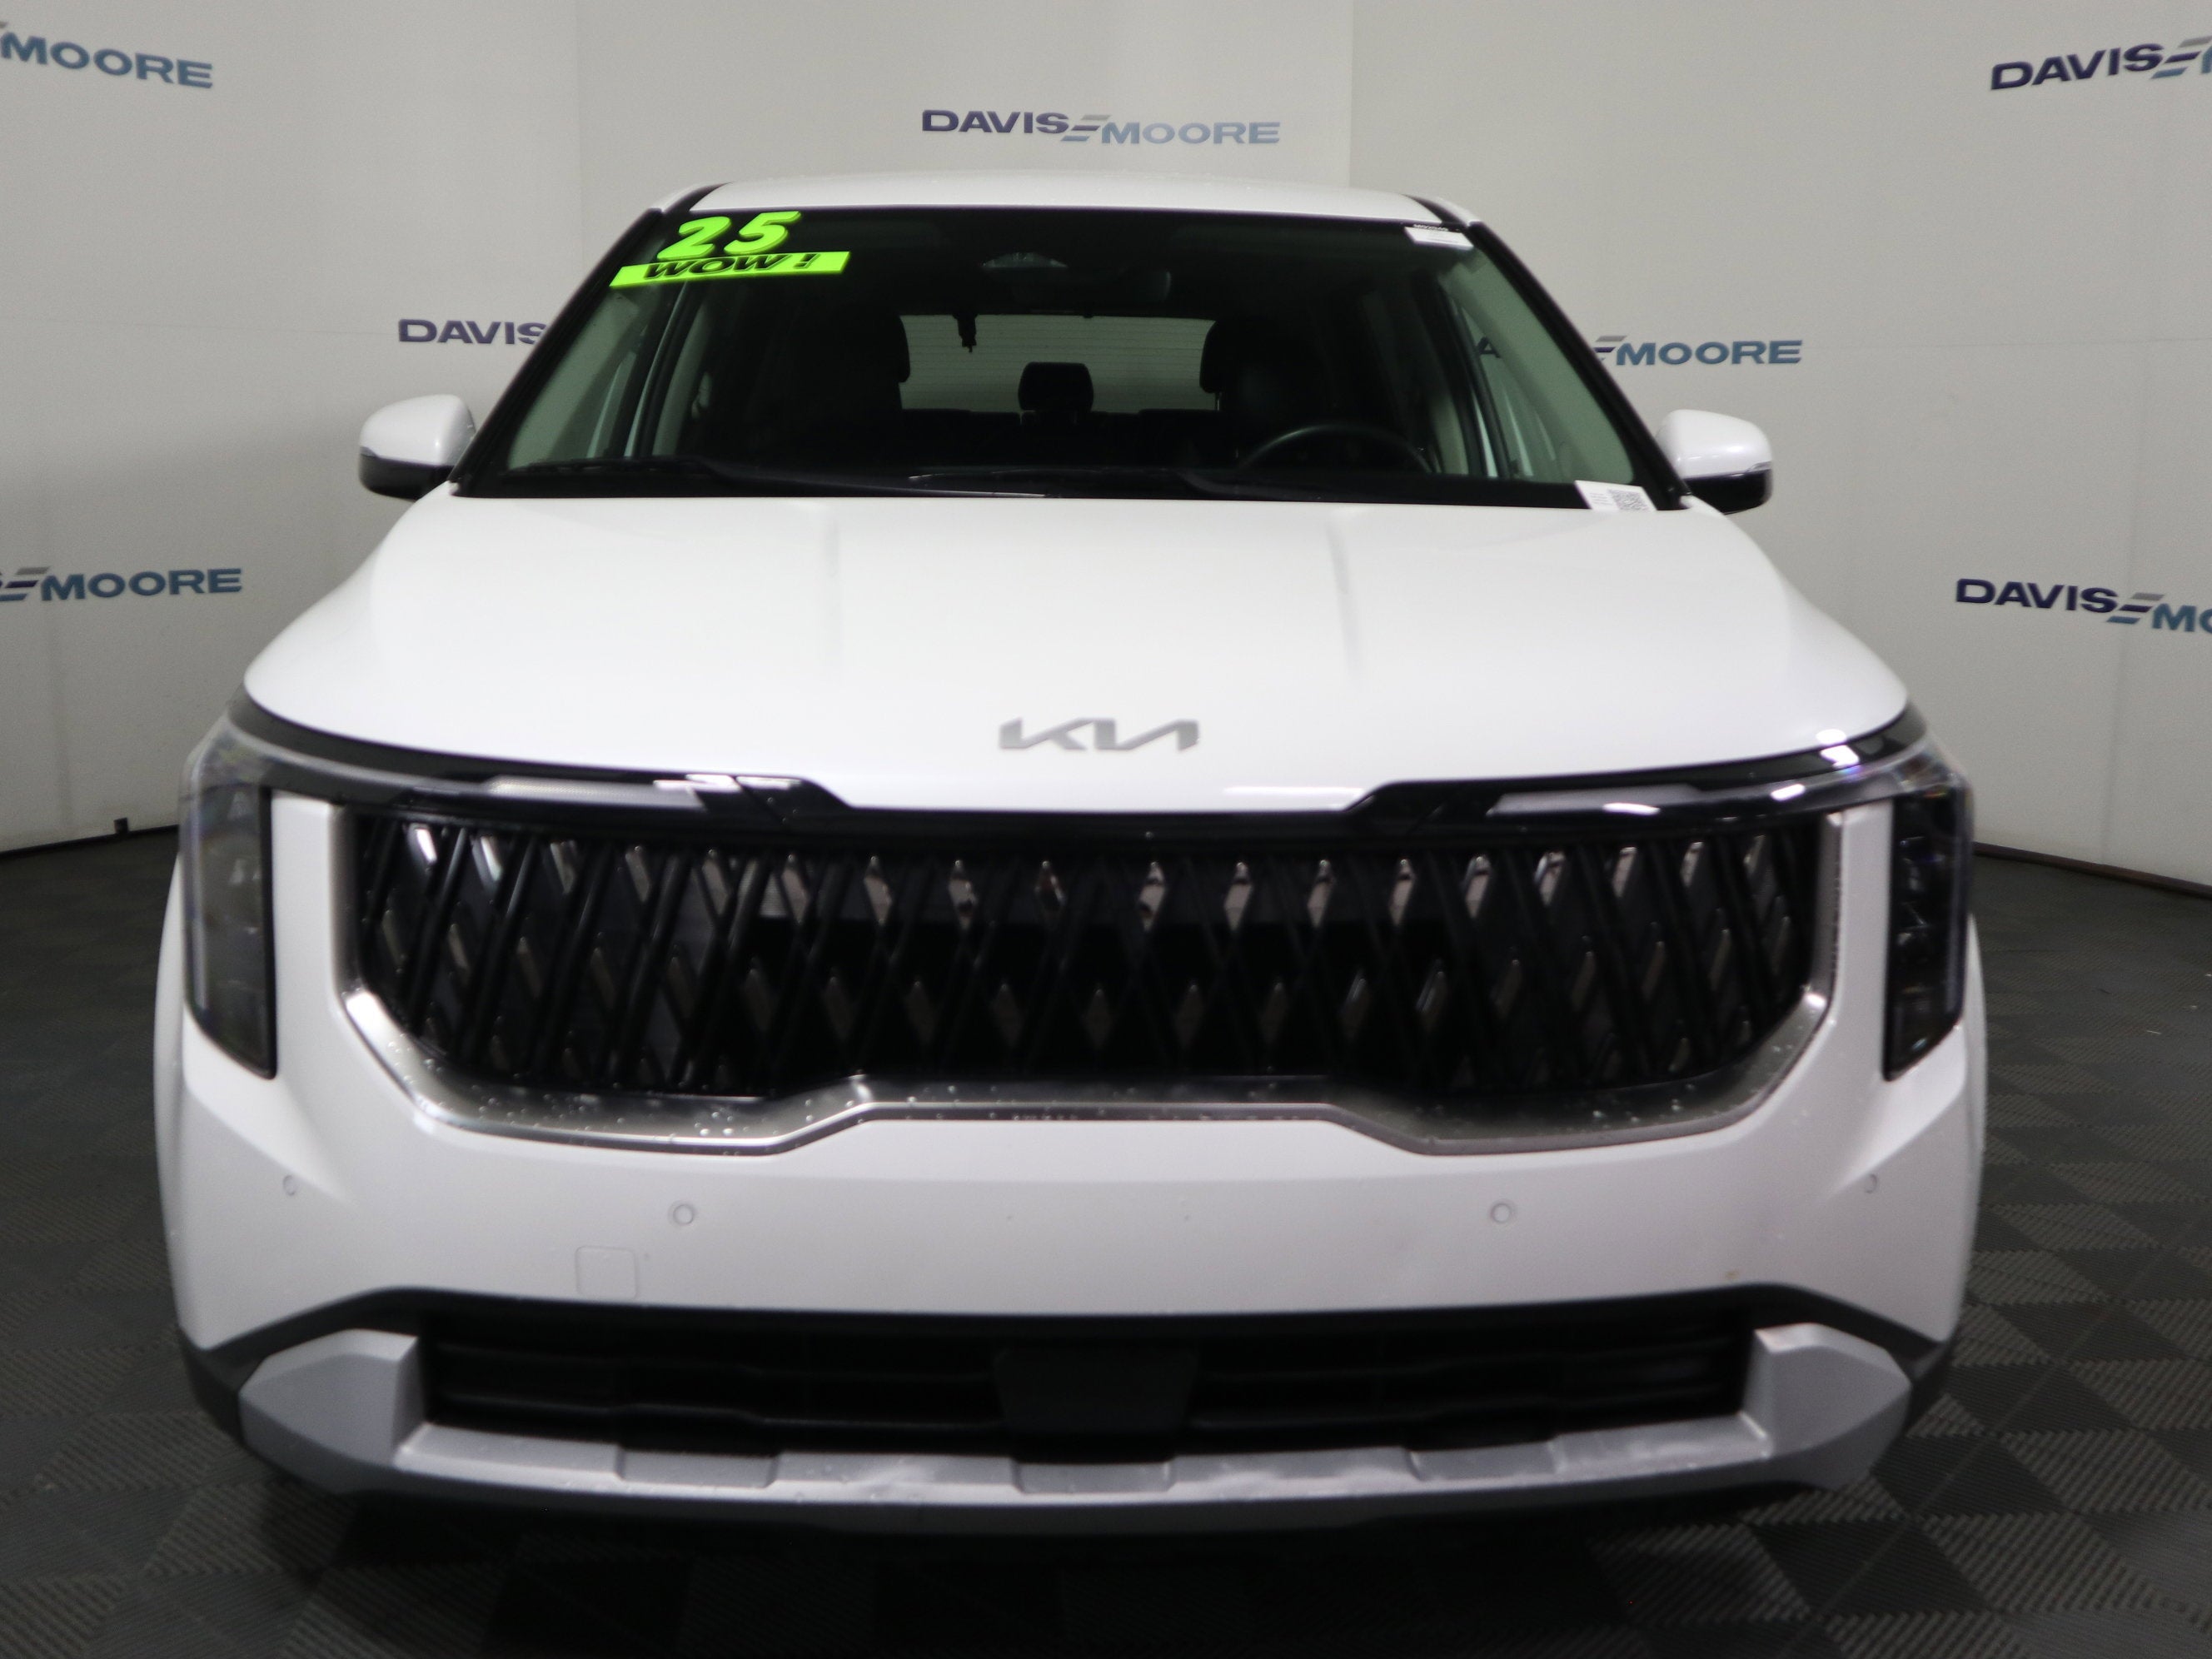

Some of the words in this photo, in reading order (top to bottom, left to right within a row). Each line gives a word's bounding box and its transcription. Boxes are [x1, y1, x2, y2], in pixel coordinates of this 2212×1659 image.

[0, 32, 212, 89] MOORE
[1990, 43, 2165, 91] DAVIS
[922, 110, 1069, 133] DAVIS
[1101, 122, 1280, 145] MOORE
[656, 211, 801, 261] 25
[398, 319, 546, 345] DAVIS
[1616, 340, 1802, 366] MOORE
[42, 568, 242, 601] MOORE
[1956, 578, 2119, 613] DAVIS
[999, 717, 1199, 752] KIA
